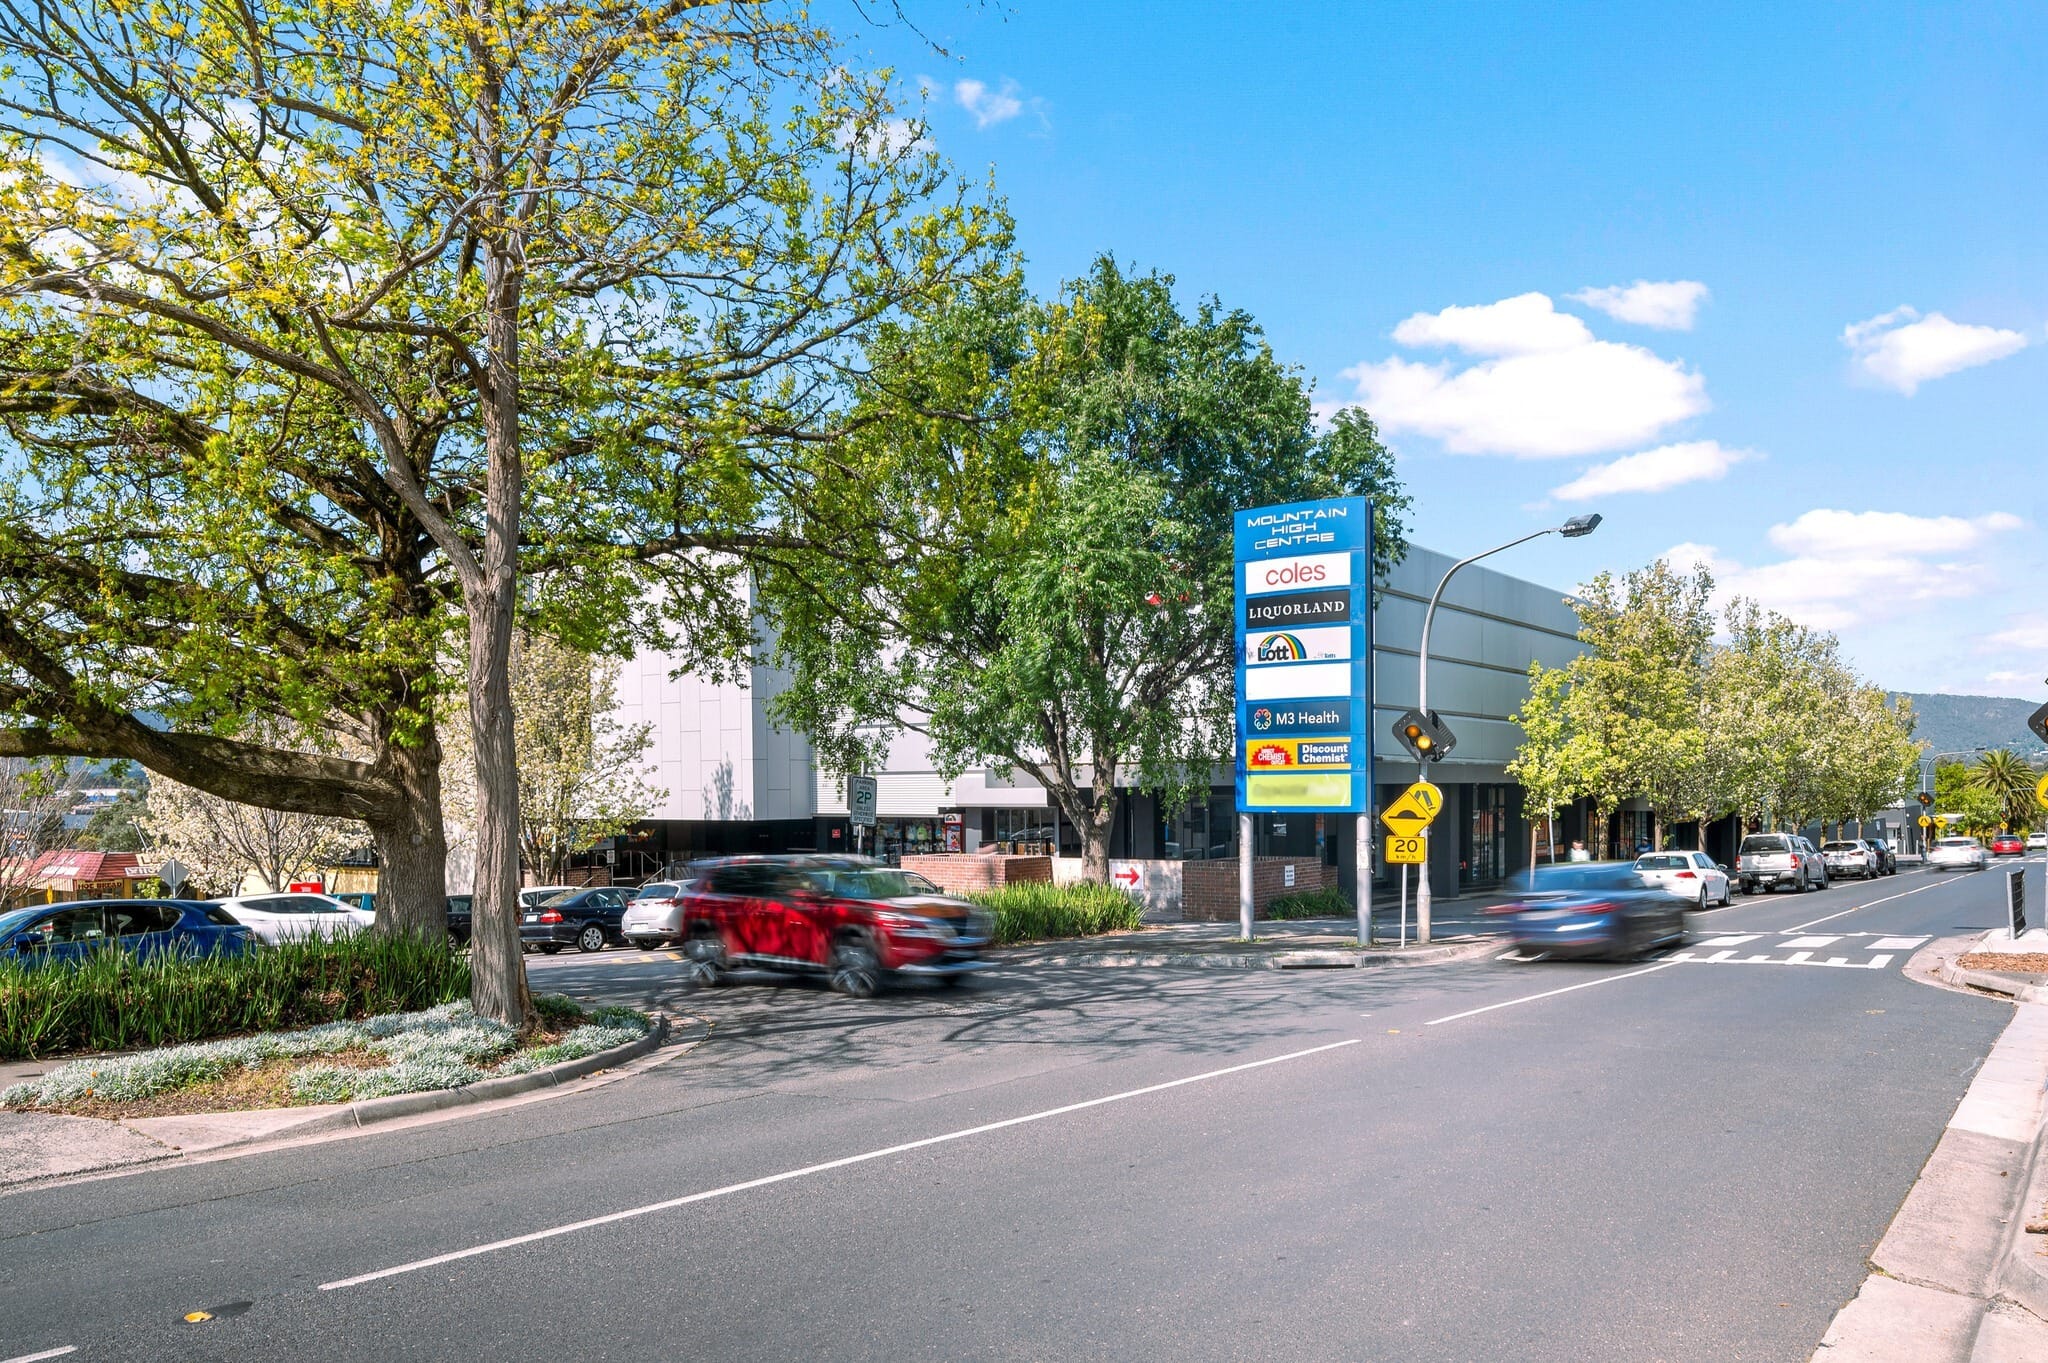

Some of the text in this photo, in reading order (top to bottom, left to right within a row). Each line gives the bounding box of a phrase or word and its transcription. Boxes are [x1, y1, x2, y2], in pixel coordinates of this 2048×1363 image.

[1248, 507, 1347, 527] MOUNTAIN
[1272, 522, 1316, 535] HIGH
[1255, 532, 1334, 550] CENTRE
[1266, 562, 1326, 585] coles
[1249, 601, 1345, 620] LIQUORLAND
[1258, 645, 1289, 661] Lott
[1276, 710, 1340, 725] M3 Health
[1302, 744, 1348, 753] Discount
[1258, 753, 1285, 761] CHEMIST
[1302, 754, 1346, 763] Chemist
[856, 791, 872, 804] 2P
[1395, 839, 1418, 853] 20
